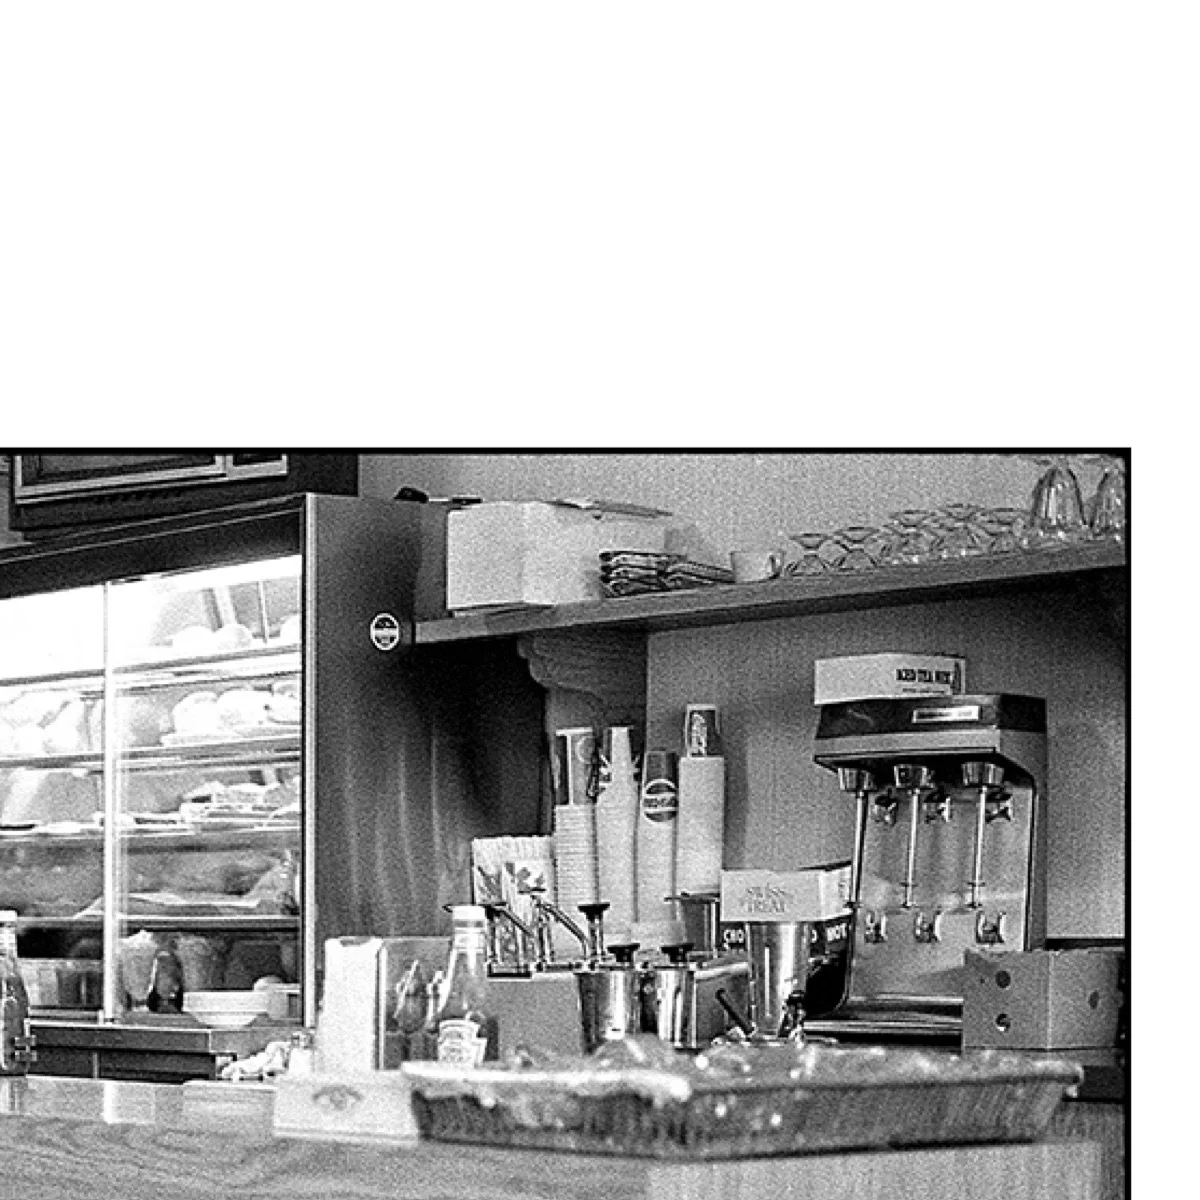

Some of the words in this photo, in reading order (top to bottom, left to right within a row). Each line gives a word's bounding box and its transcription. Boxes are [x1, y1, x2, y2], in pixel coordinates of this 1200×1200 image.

[895, 668, 916, 681] ICED
[917, 669, 934, 683] TEA
[935, 670, 952, 685] MIX
